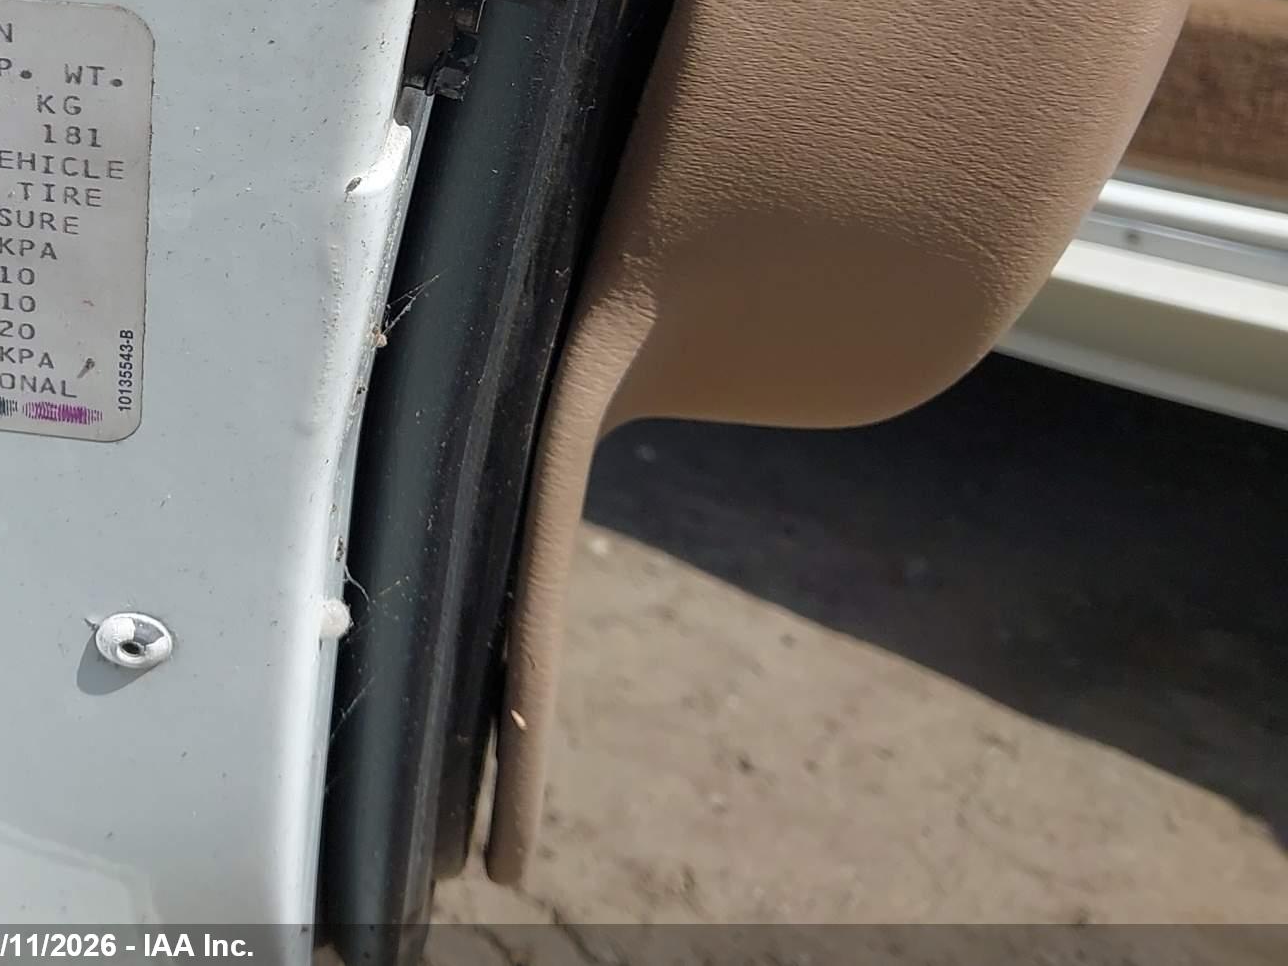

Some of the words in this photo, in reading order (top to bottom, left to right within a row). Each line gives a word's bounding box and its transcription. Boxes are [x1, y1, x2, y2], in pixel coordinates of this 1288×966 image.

[65, 64, 123, 87] WT.
[37, 95, 81, 115] KG
[43, 124, 101, 147] 181
[17, 182, 101, 207] TIRE
[118, 330, 133, 411] 10135543-B
